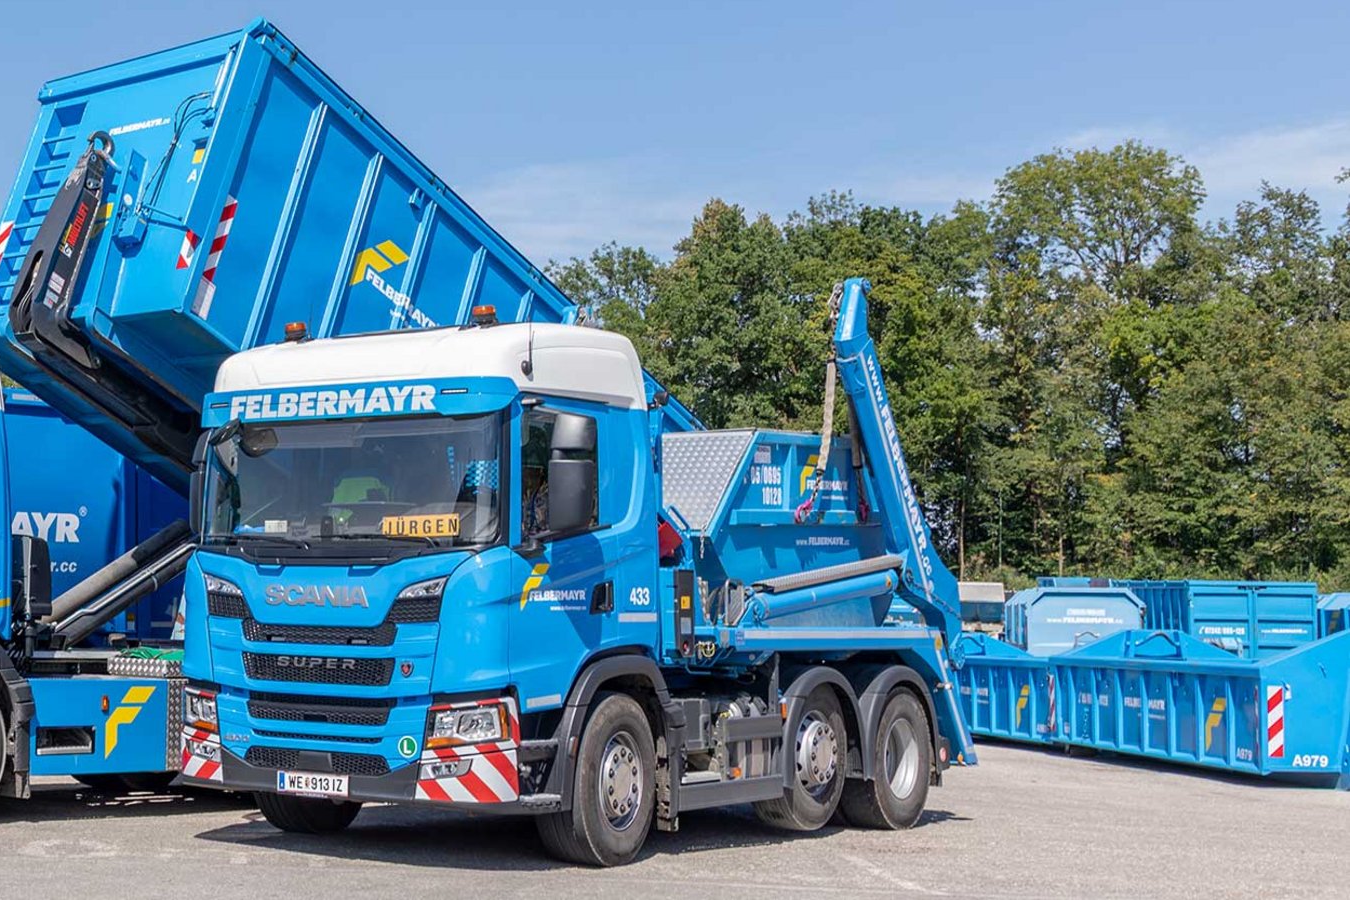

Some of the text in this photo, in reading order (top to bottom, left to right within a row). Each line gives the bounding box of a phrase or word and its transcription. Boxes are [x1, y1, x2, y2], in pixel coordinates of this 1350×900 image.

[230, 384, 437, 421] FELBERMAYR
[384, 516, 458, 536] JÜRGEN
[265, 584, 369, 608] SCANIA
[529, 589, 586, 601] FELBERMAYR
[630, 587, 650, 605] 433
[277, 656, 356, 669] SUPER
[1236, 747, 1253, 761] A979
[1292, 753, 1329, 768] A979
[288, 777, 303, 789] WE
